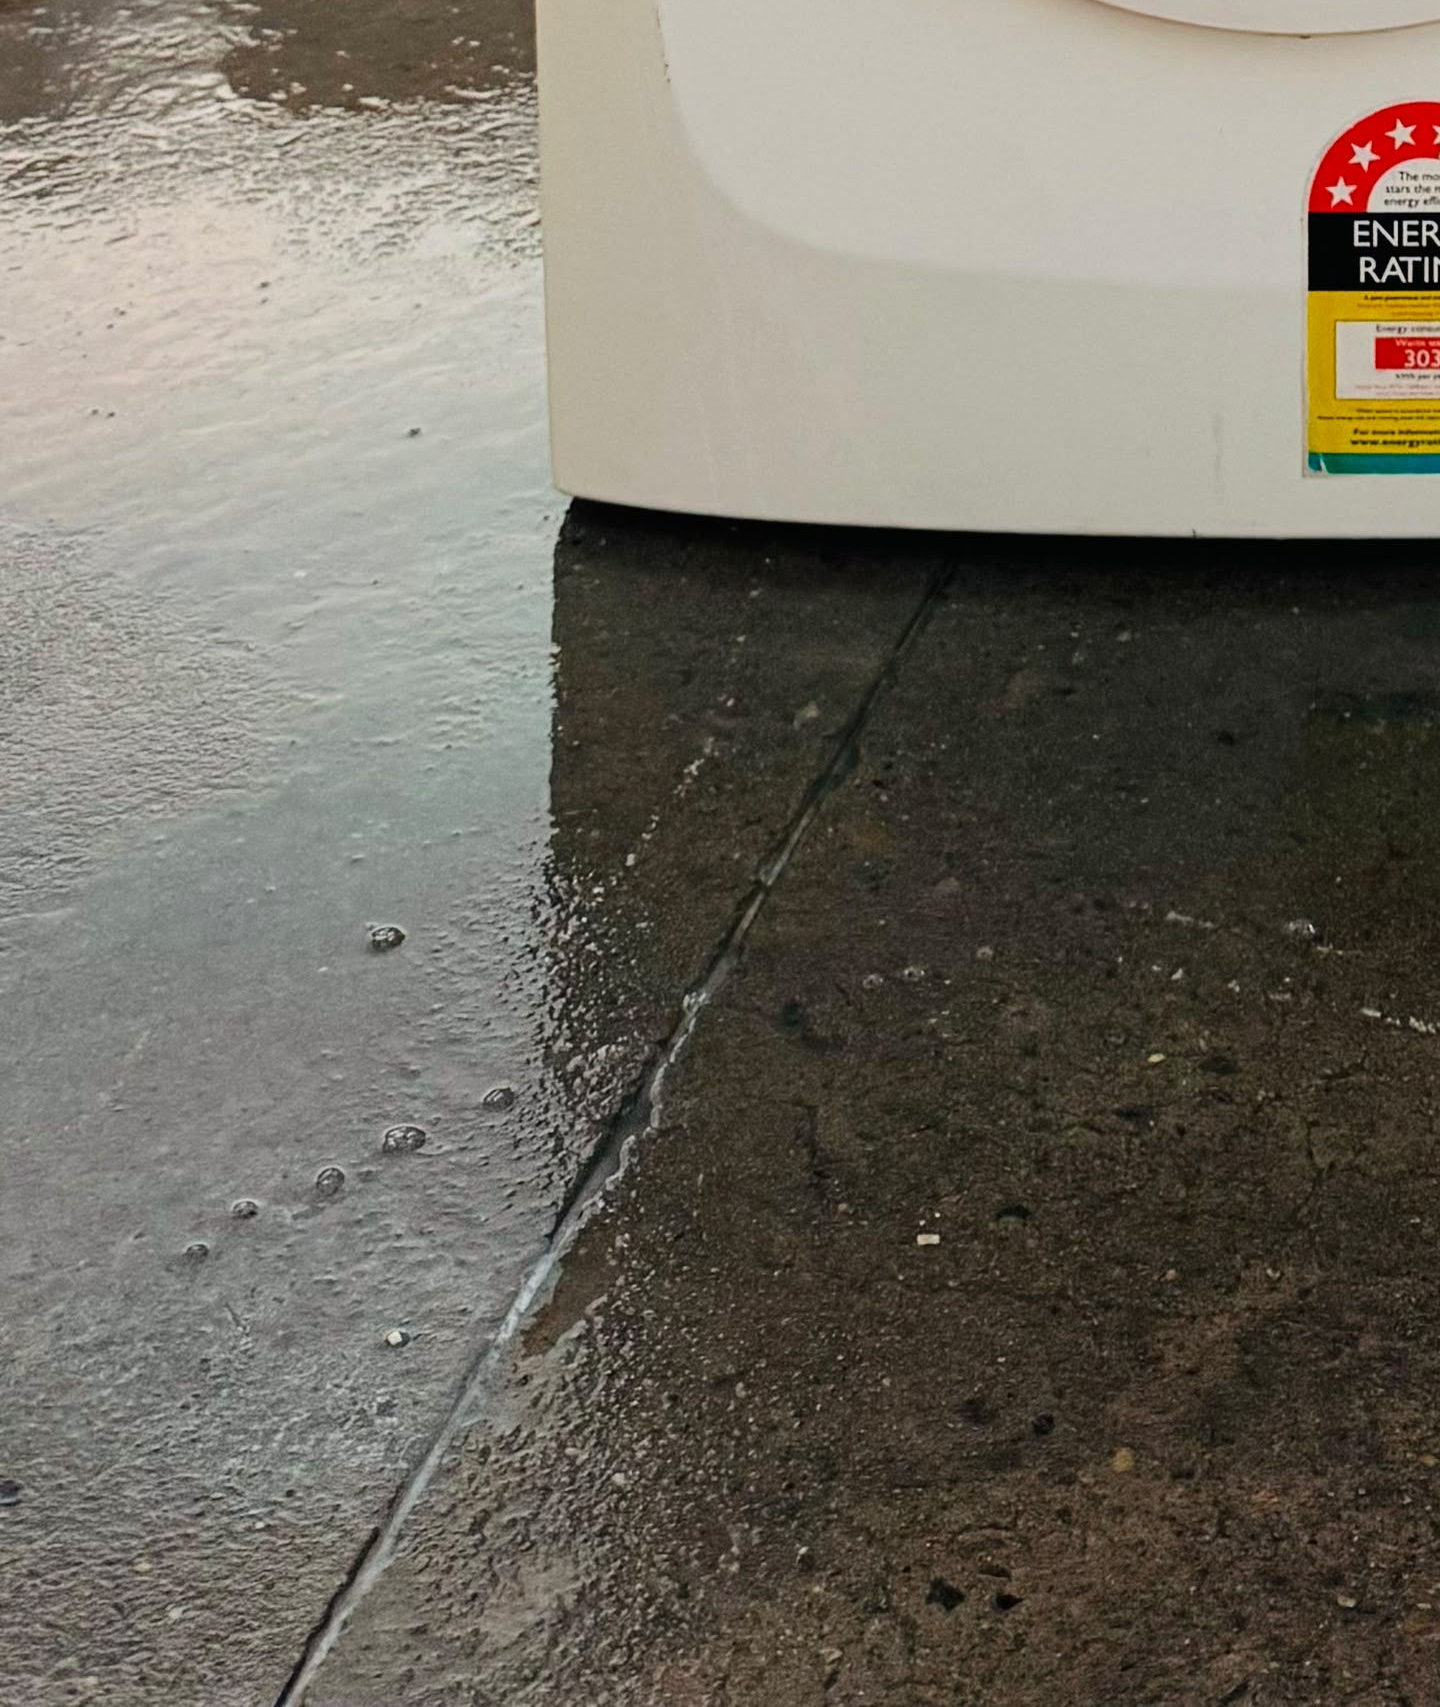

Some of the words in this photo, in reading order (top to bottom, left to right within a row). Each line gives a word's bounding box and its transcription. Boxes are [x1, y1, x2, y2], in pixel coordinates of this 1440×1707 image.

[1399, 171, 1419, 181] The
[1385, 185, 1410, 194] stars
[1414, 185, 1430, 194] the
[1384, 197, 1420, 208] energy
[1375, 324, 1408, 333] Energy
[1395, 338, 1425, 347] Warm
